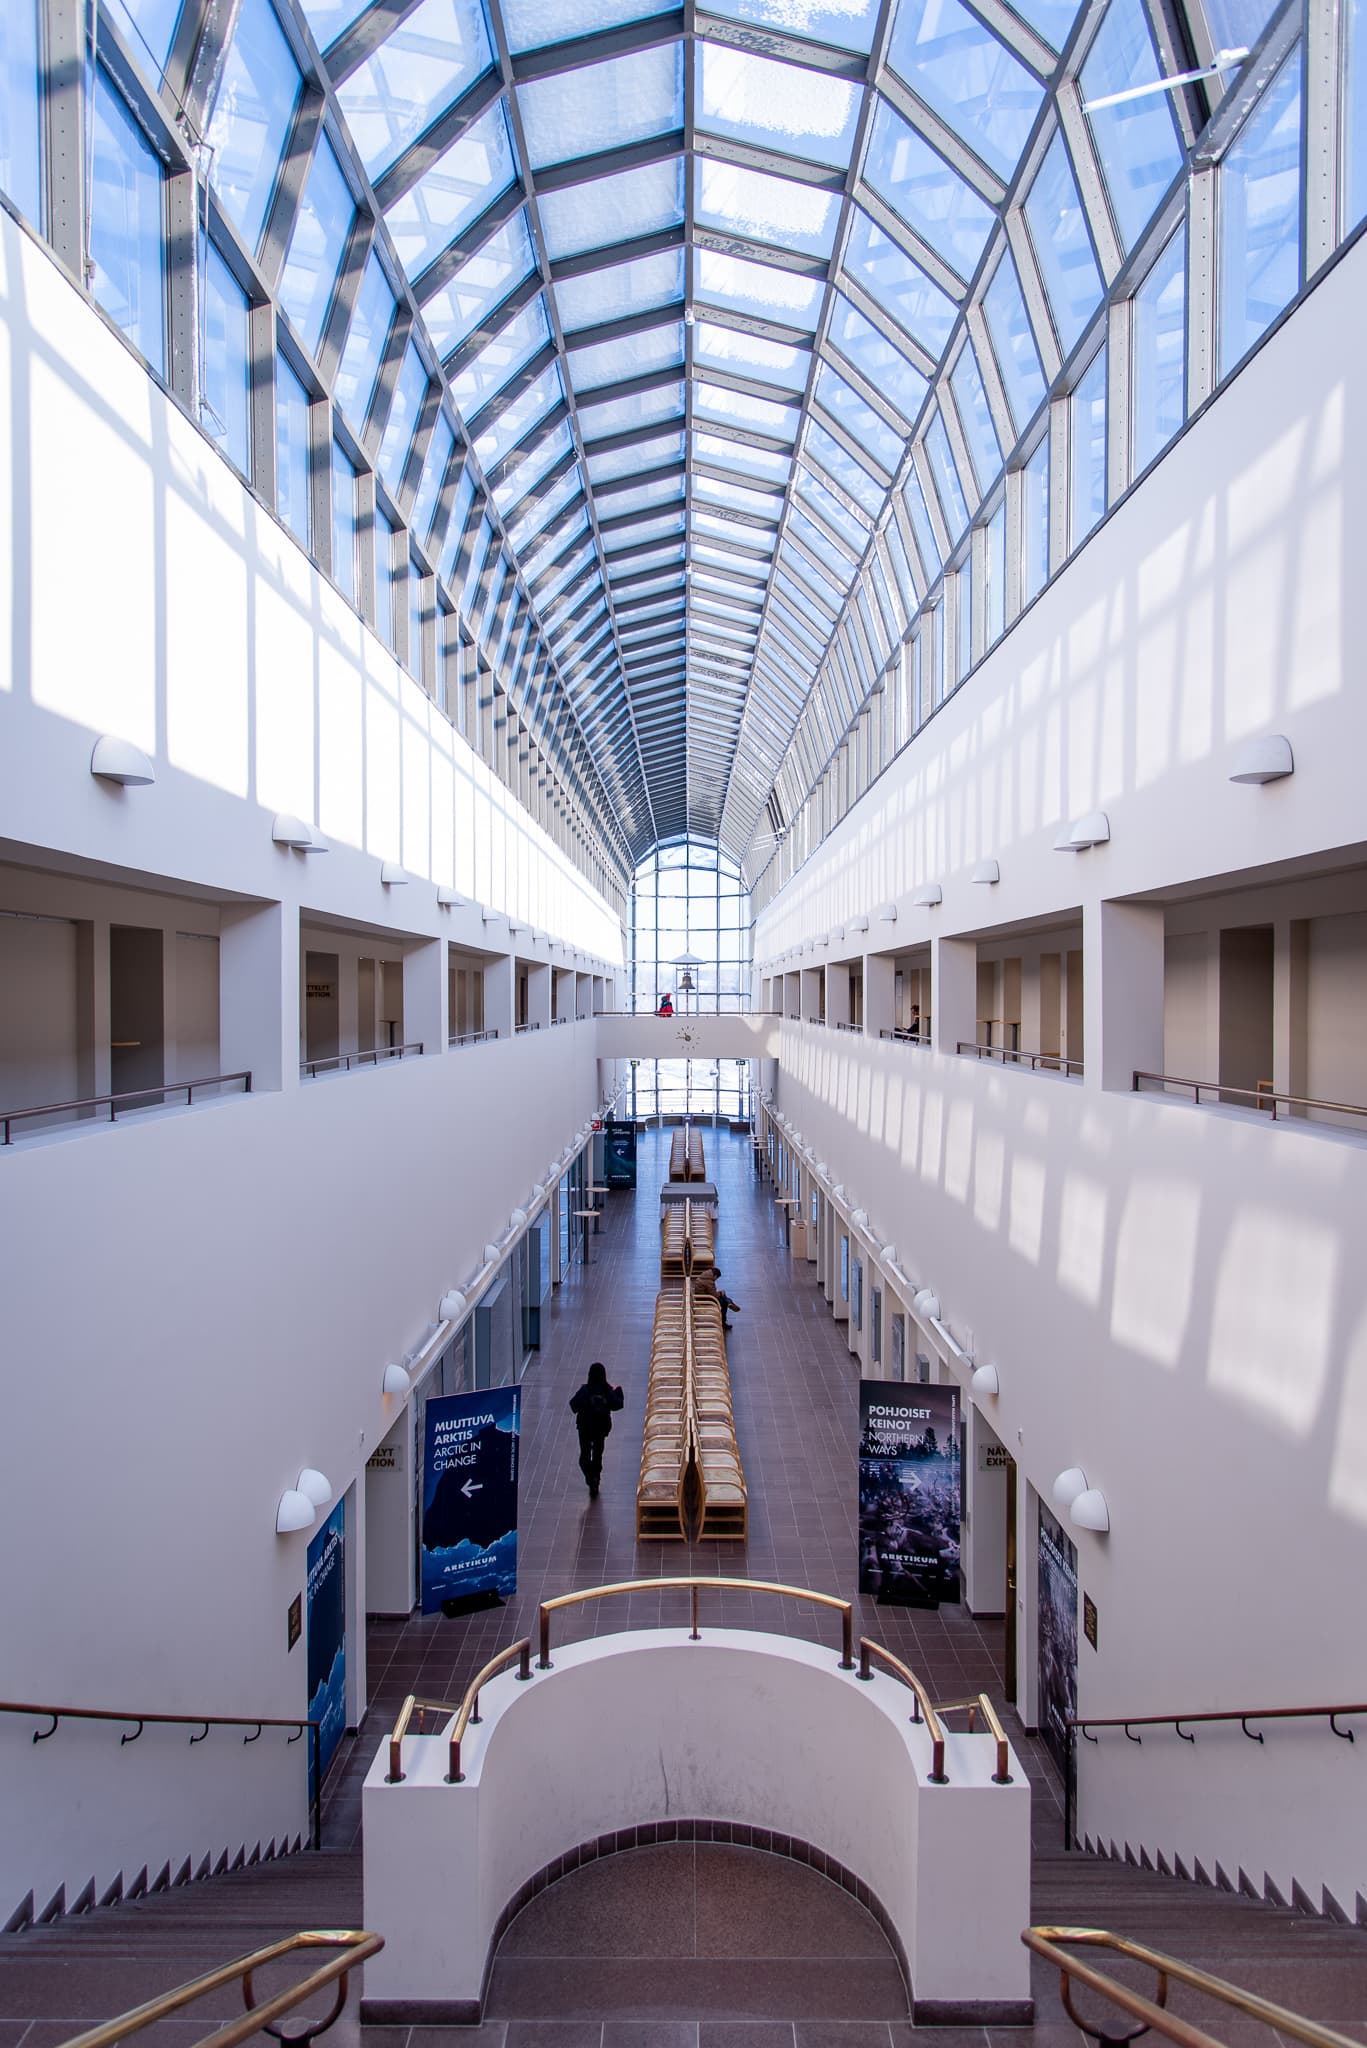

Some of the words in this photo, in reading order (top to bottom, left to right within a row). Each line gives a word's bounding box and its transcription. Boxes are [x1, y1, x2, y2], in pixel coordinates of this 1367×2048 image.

[868, 1405, 932, 1419] POHJOISET
[434, 1413, 495, 1433] MUUTTUVA
[868, 1418, 912, 1431] KEINOT
[434, 1430, 473, 1446] ARKTIS
[868, 1432, 924, 1445] NORTHERN
[433, 1443, 469, 1459] ARCTIC
[470, 1441, 481, 1452] IN
[868, 1444, 898, 1456] WAYS
[987, 1446, 1011, 1456] NÄY
[433, 1454, 477, 1471] CHANGE
[443, 1556, 497, 1573] ARKTIKUM
[881, 1553, 938, 1564] ARKTIKUM
